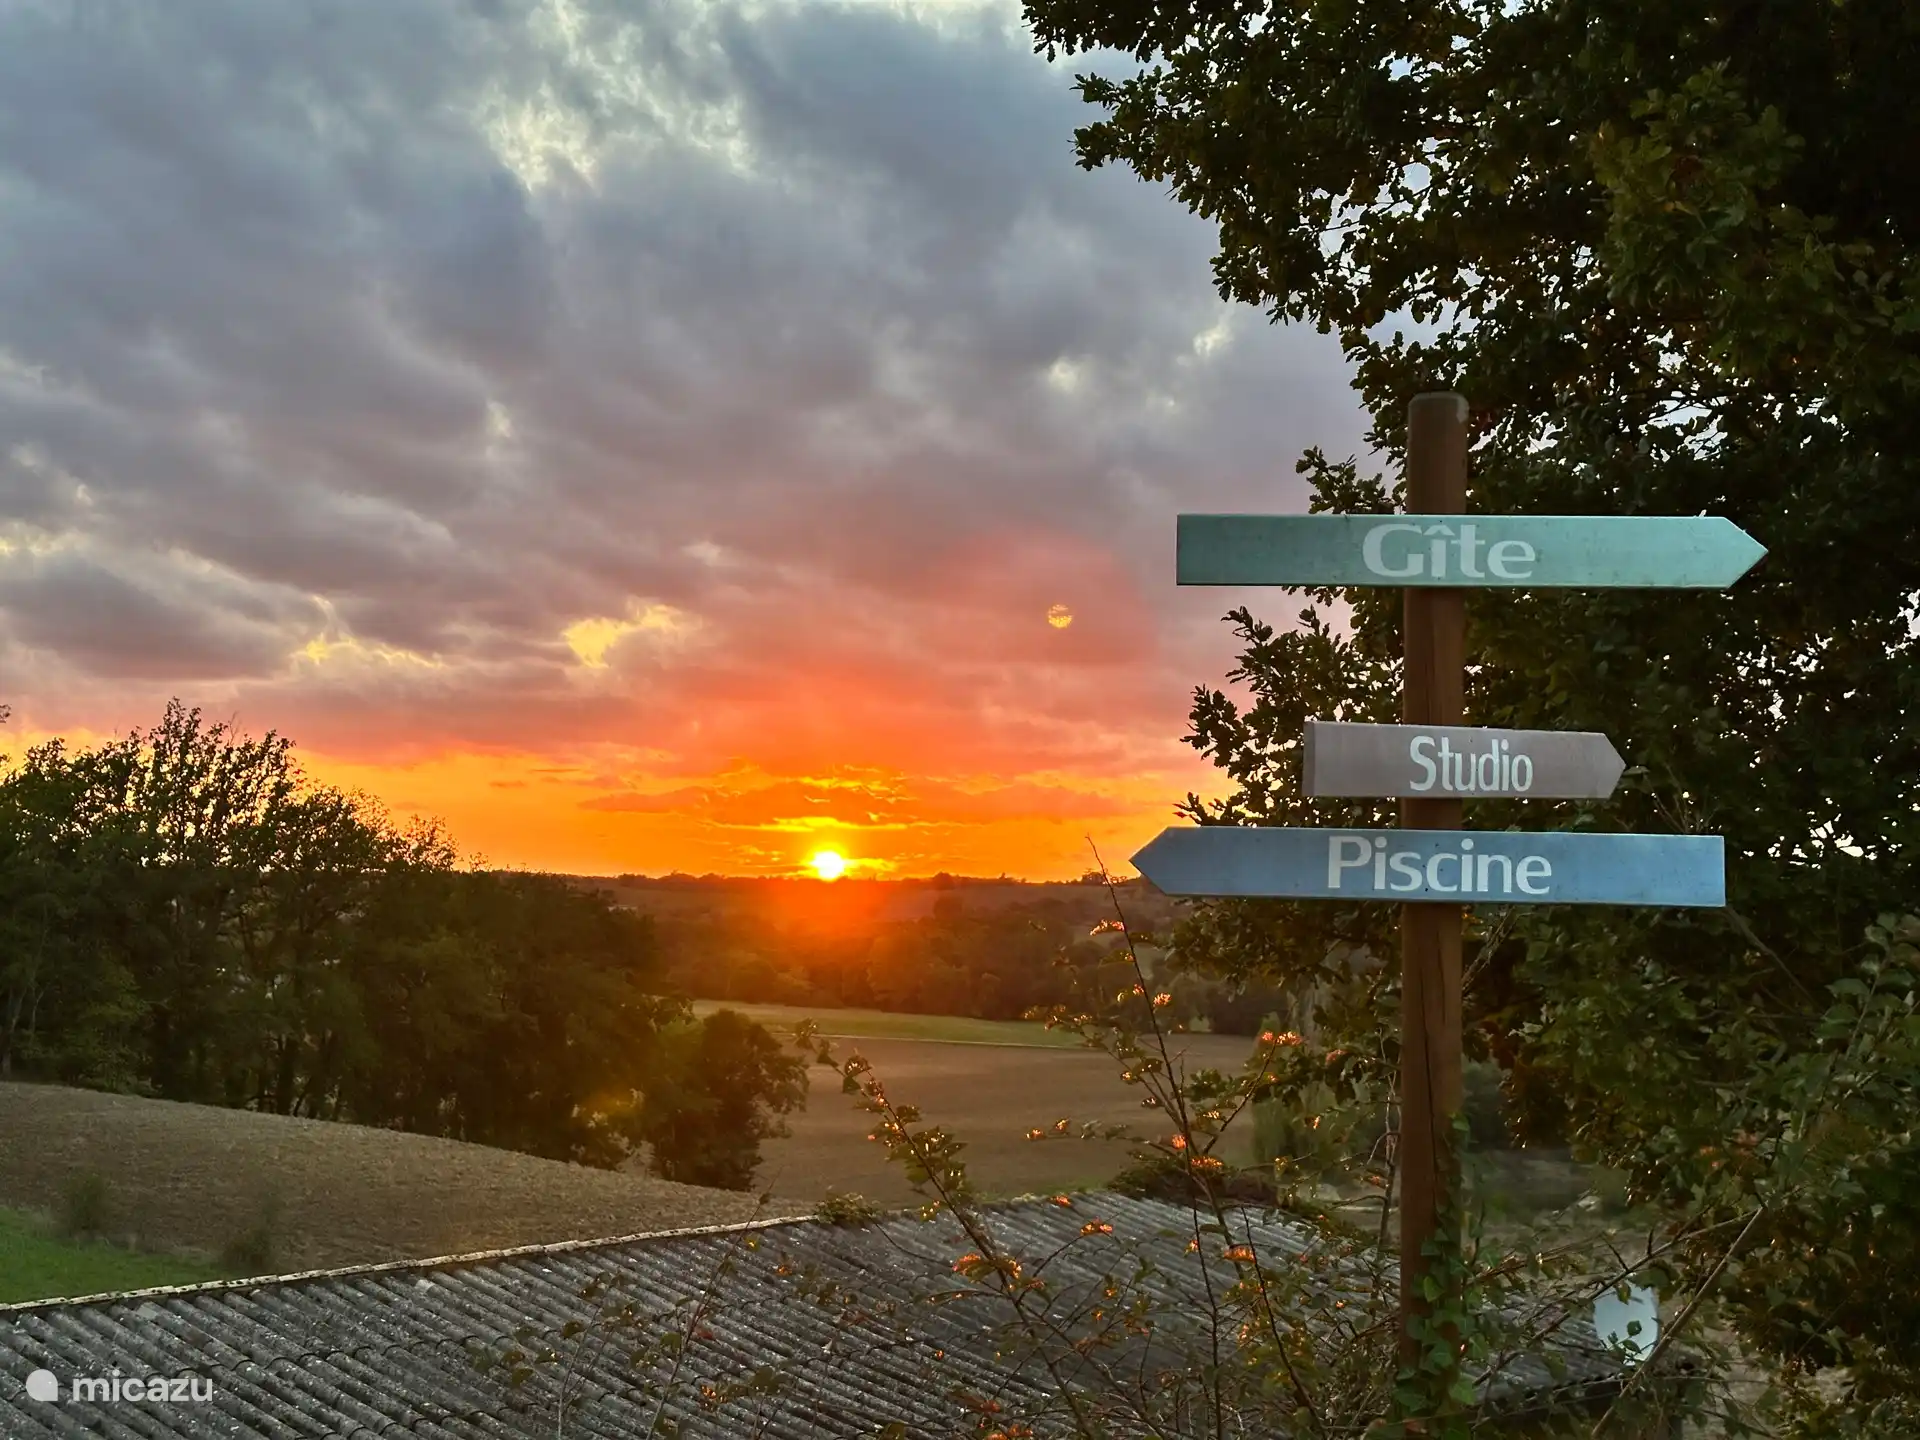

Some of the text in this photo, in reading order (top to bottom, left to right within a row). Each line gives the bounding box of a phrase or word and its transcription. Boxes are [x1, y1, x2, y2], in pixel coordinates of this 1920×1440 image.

[1362, 523, 1536, 579] Gîte
[1409, 735, 1534, 792] Studio
[1328, 835, 1552, 895] Piscine
